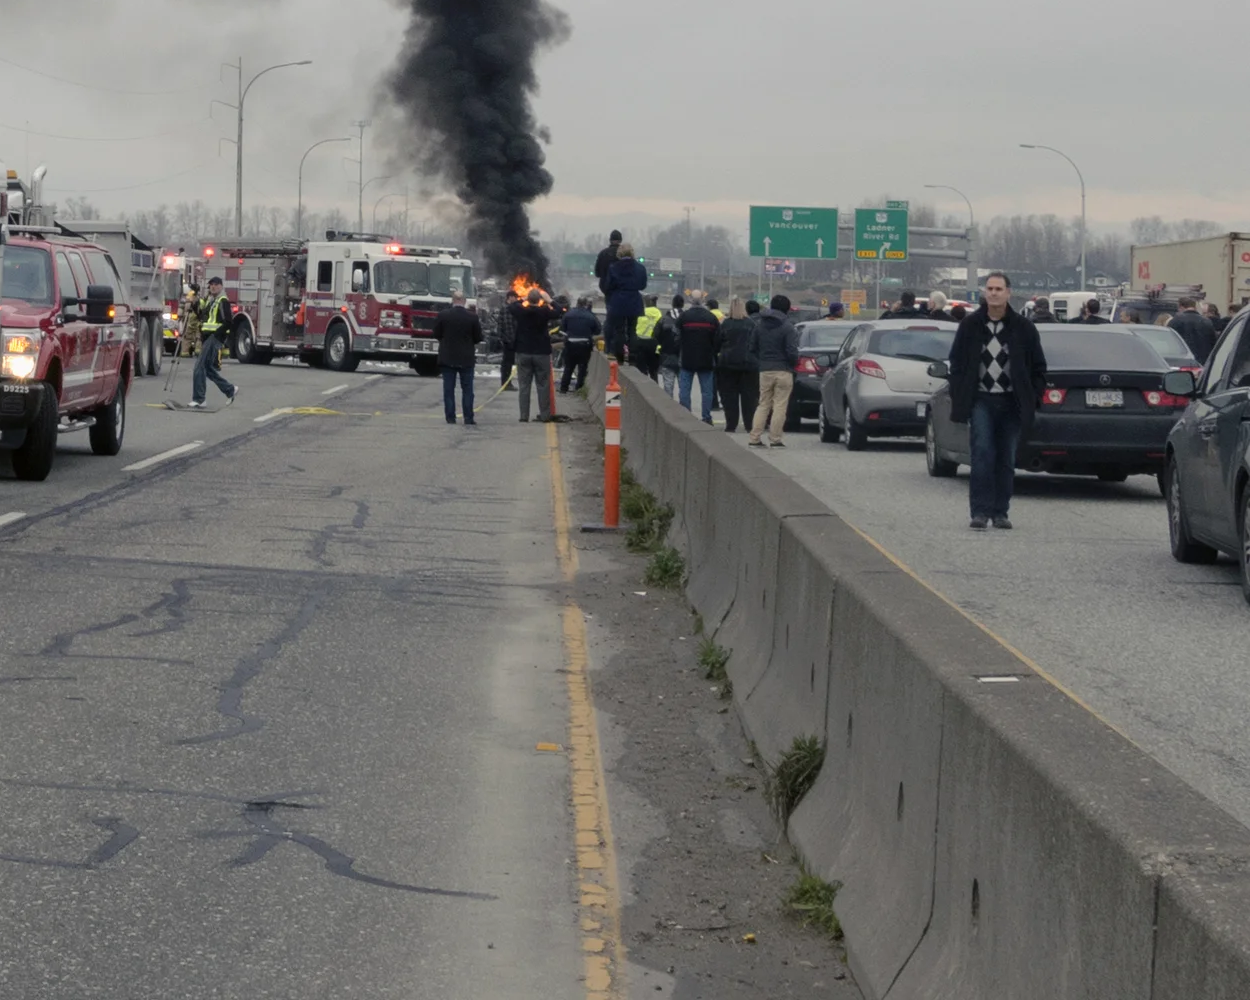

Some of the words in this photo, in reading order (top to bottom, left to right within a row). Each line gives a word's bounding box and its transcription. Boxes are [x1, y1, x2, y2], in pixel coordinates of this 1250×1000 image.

[768, 221, 818, 230] Vancouver
[862, 232, 885, 240] River
[888, 233, 899, 241] Rd
[3, 384, 30, 394] D9225
